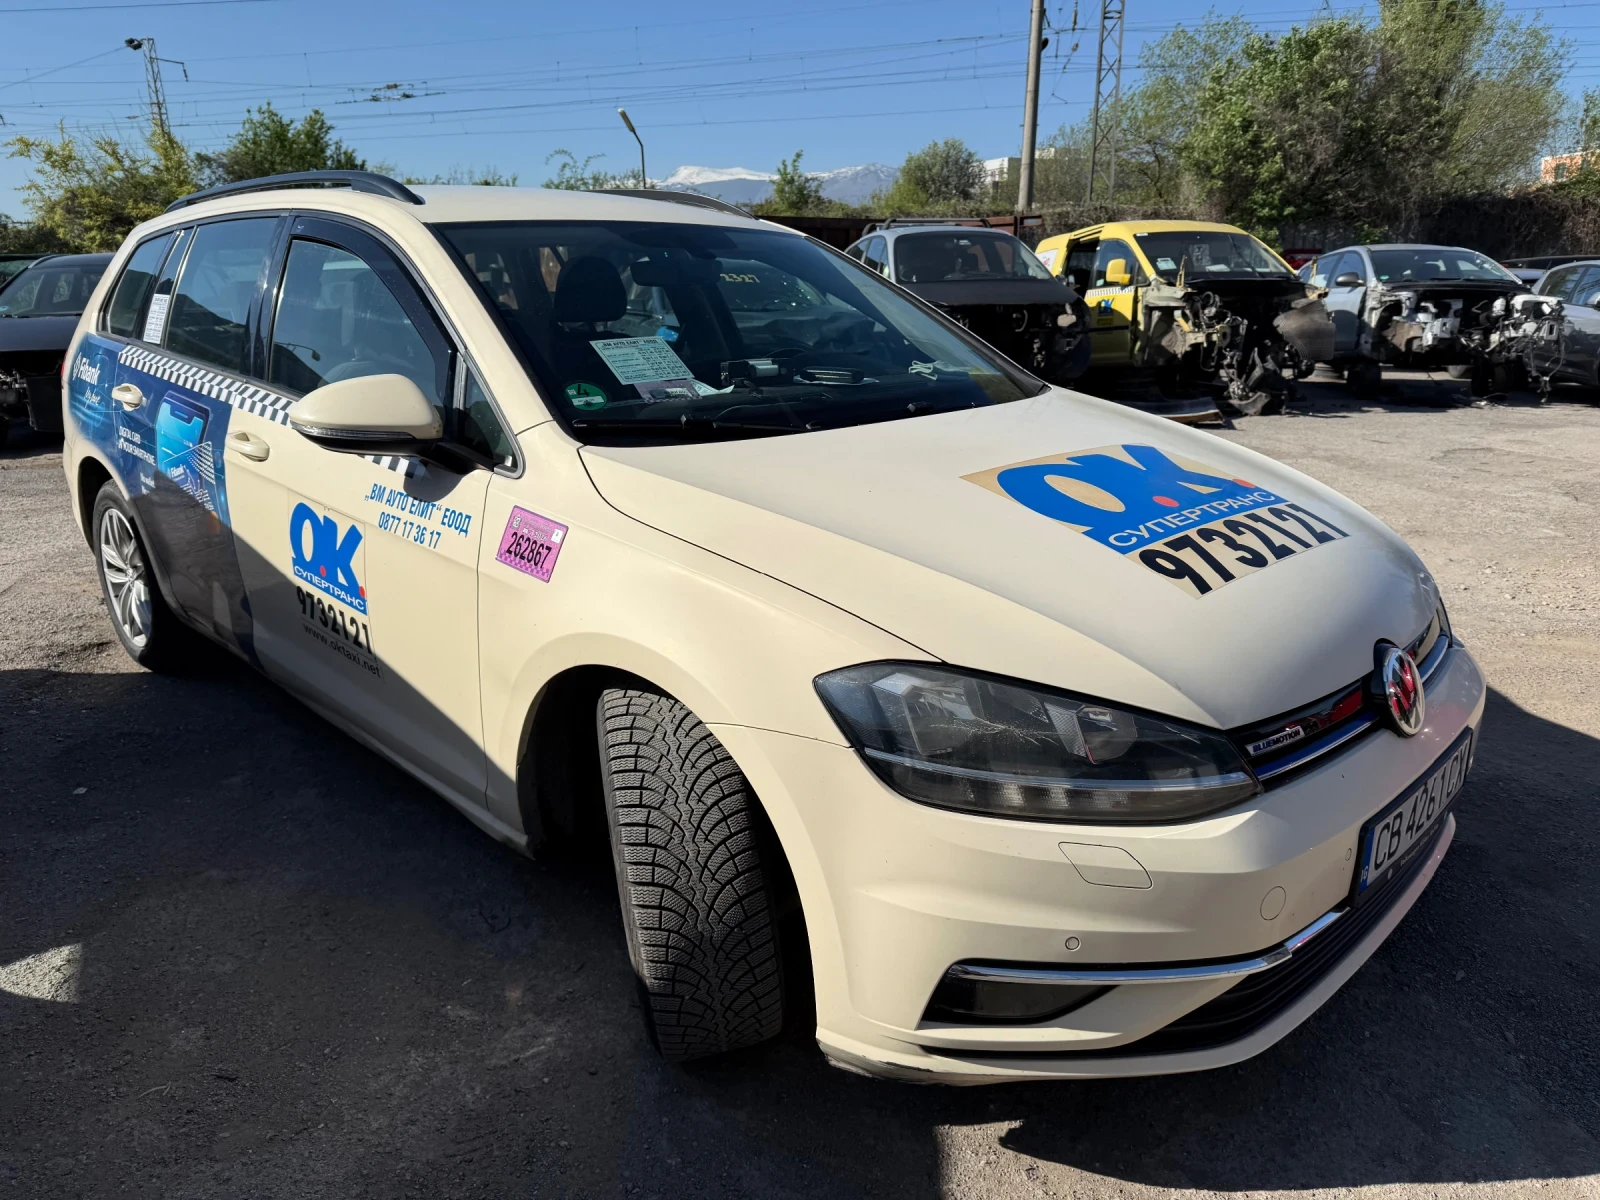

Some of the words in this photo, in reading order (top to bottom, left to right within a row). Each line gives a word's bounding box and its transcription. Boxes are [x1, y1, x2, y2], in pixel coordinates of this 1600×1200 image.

[720, 273, 760, 283] 2327
[78, 357, 100, 385] Fibank
[577, 384, 589, 396] 4
[364, 483, 386, 504] „ВМ
[385, 489, 409, 511] АУТО
[409, 496, 443, 521] ЕЛИТ“
[441, 507, 472, 538] ЕООД
[378, 511, 401, 534] 0877
[402, 520, 415, 539] 17
[413, 524, 427, 544] 36
[428, 530, 441, 549] 17
[1108, 491, 1276, 547] СУПЕРТРАНС
[506, 531, 552, 569] 262867
[1138, 503, 1351, 595] 9732121
[294, 566, 365, 610] СУПЕРТРАНС
[296, 586, 373, 655] 9732121
[302, 623, 381, 678] www.oktaxi.net
[1252, 728, 1301, 753] BLUEMOTION
[1405, 765, 1447, 840] 4261
